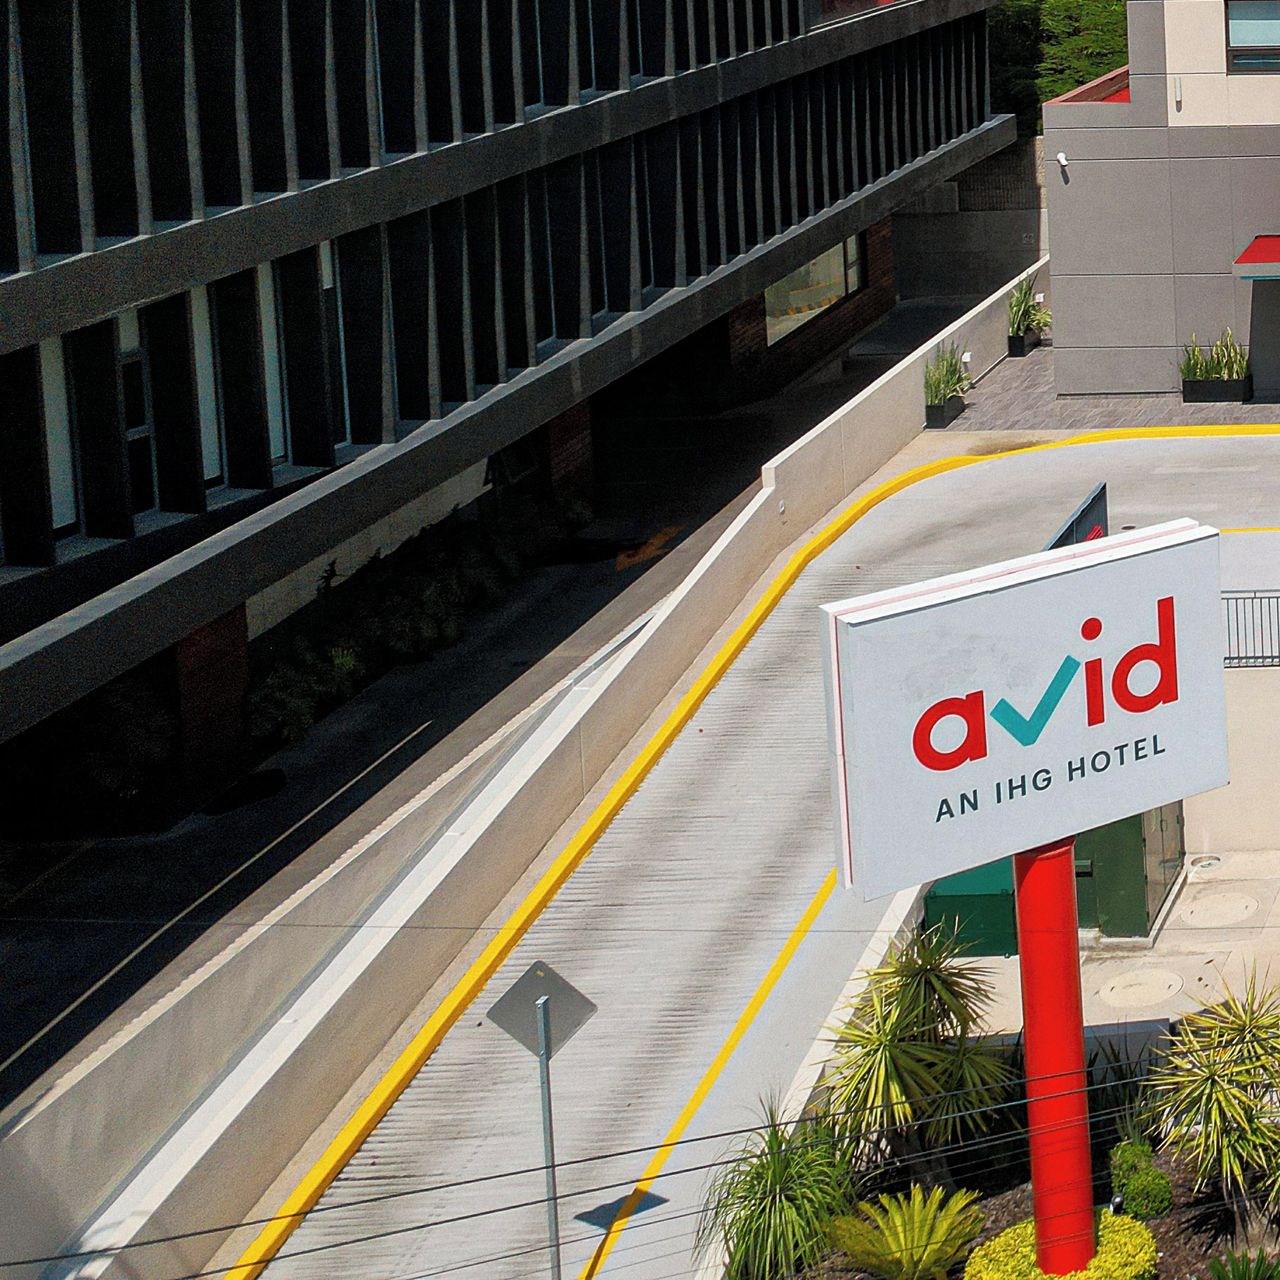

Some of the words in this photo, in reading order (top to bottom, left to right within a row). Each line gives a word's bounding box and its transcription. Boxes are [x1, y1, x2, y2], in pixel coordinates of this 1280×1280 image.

[912, 595, 1180, 772] avid
[936, 788, 979, 823] AN
[995, 768, 1052, 804] IHG
[1067, 734, 1166, 783] HOTEL
